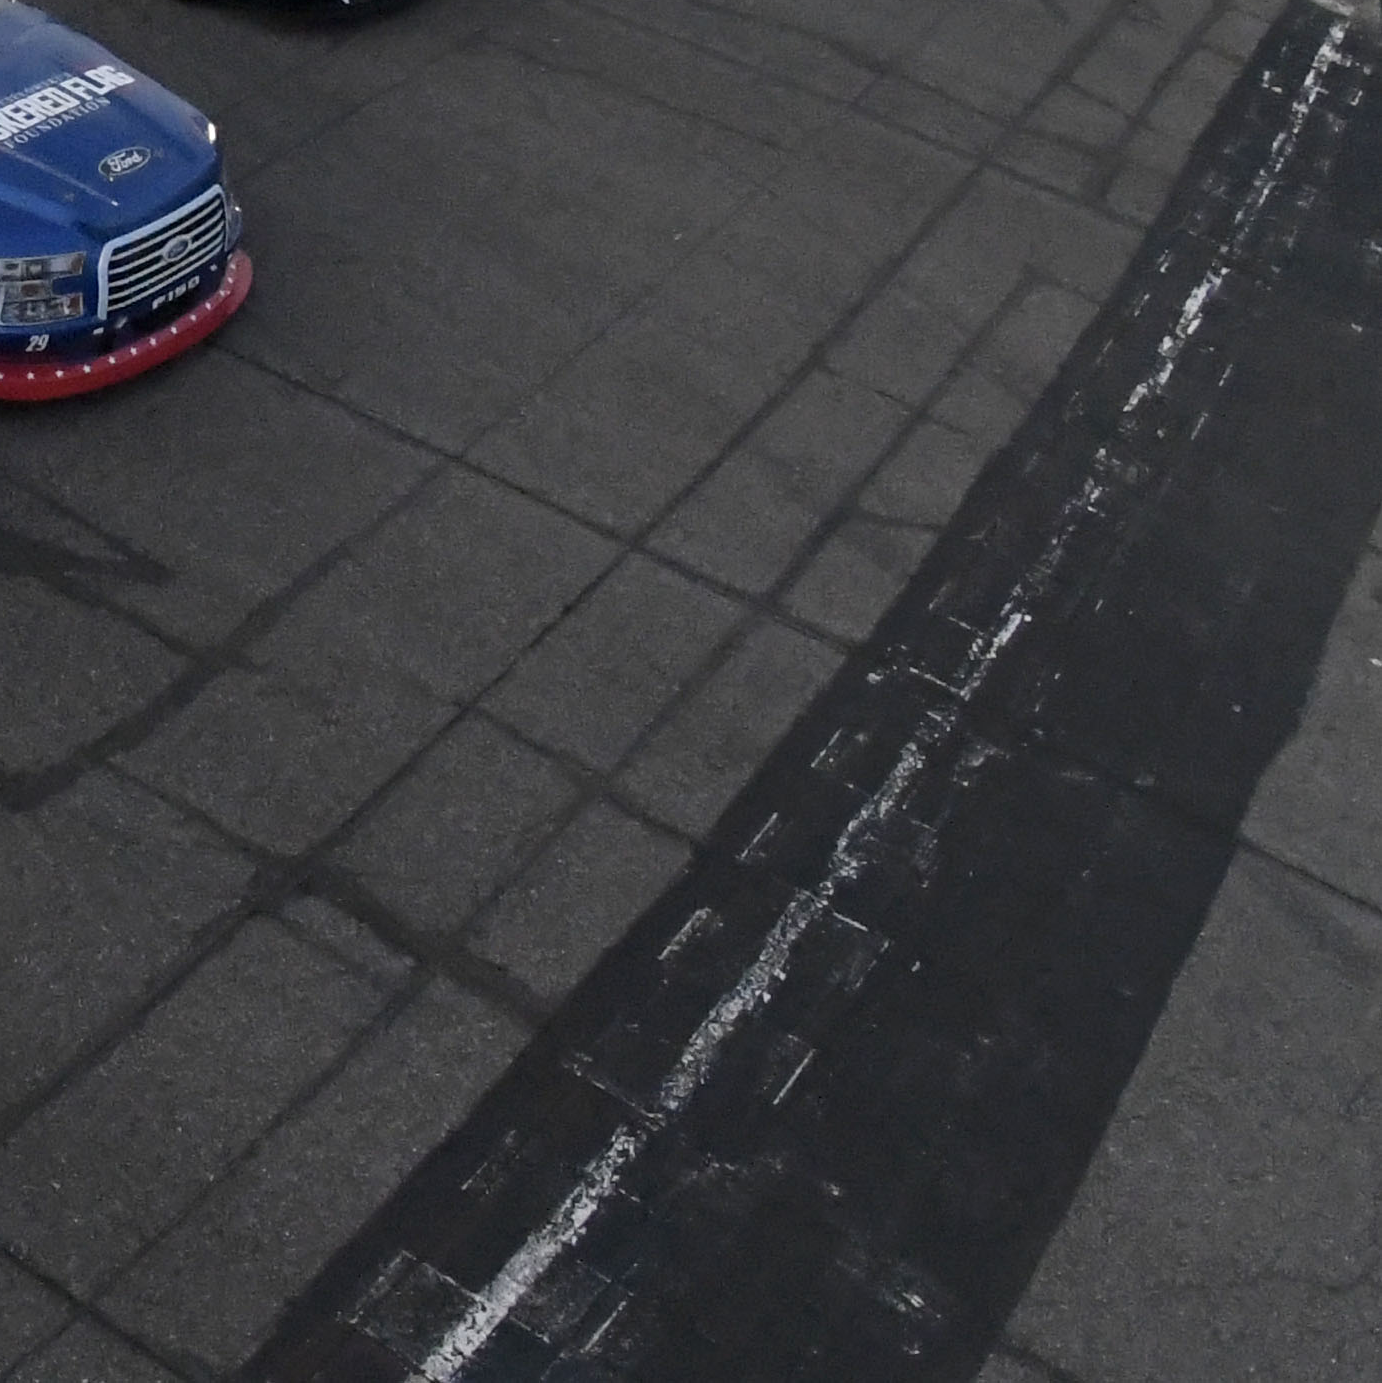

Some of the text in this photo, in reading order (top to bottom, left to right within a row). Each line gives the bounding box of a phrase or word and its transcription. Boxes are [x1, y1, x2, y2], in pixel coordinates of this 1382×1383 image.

[60, 65, 135, 101] FLAG
[3, 96, 111, 150] FOUNDATION
[25, 334, 50, 352] 29
